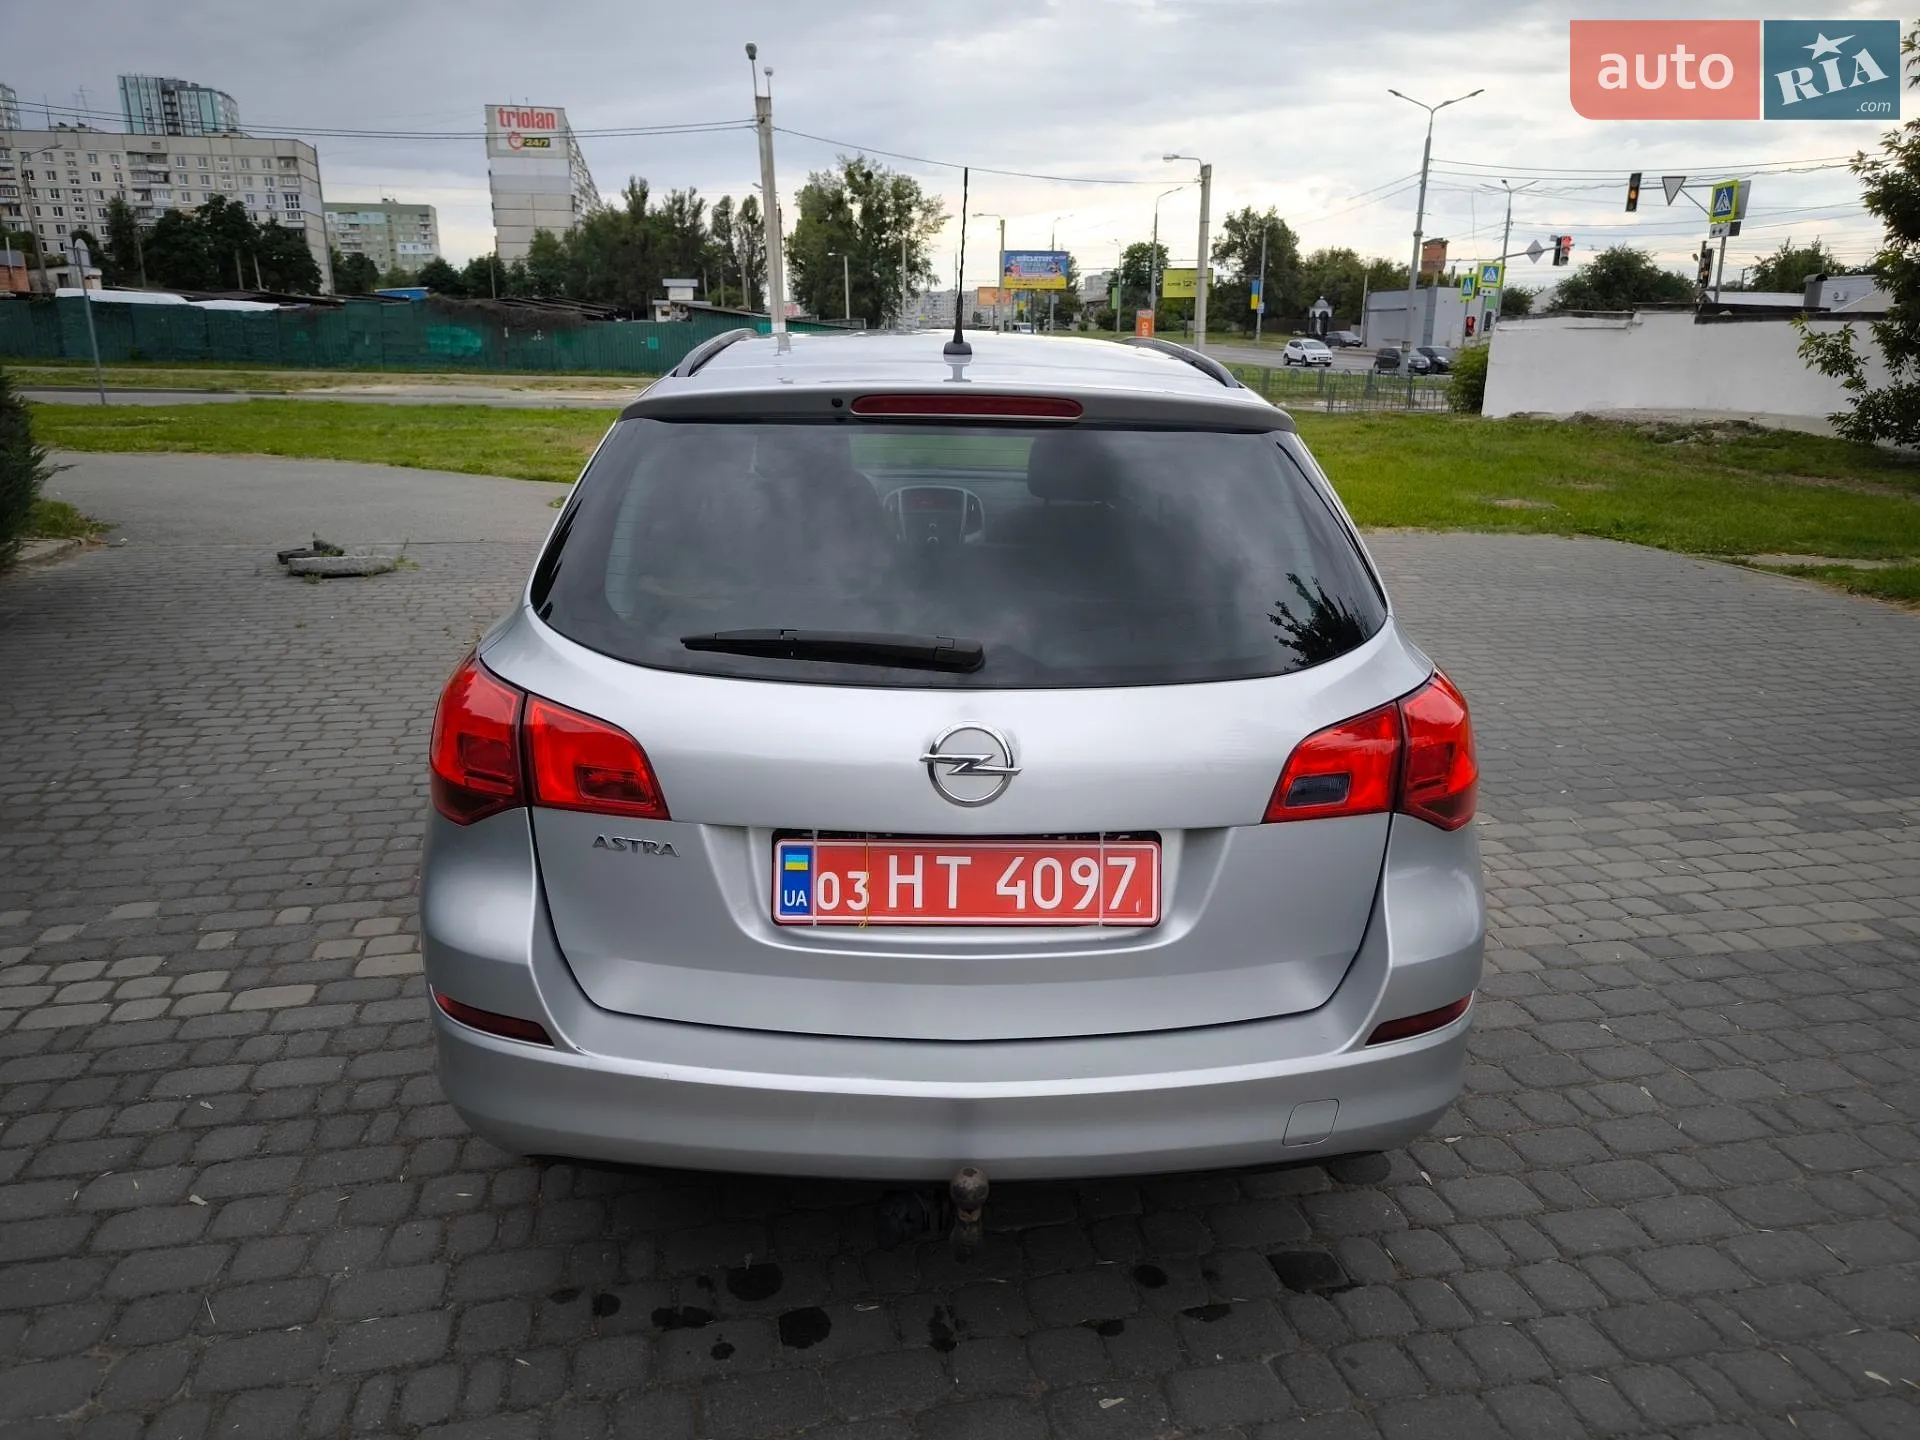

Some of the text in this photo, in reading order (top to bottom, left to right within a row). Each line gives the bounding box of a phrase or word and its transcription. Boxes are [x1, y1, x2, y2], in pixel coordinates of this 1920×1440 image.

[498, 107, 556, 129] triolan
[525, 138, 549, 147] 24/7
[592, 834, 681, 857] ASTRA
[816, 854, 1137, 911] 03 HT 4097
[784, 890, 808, 907] UA
